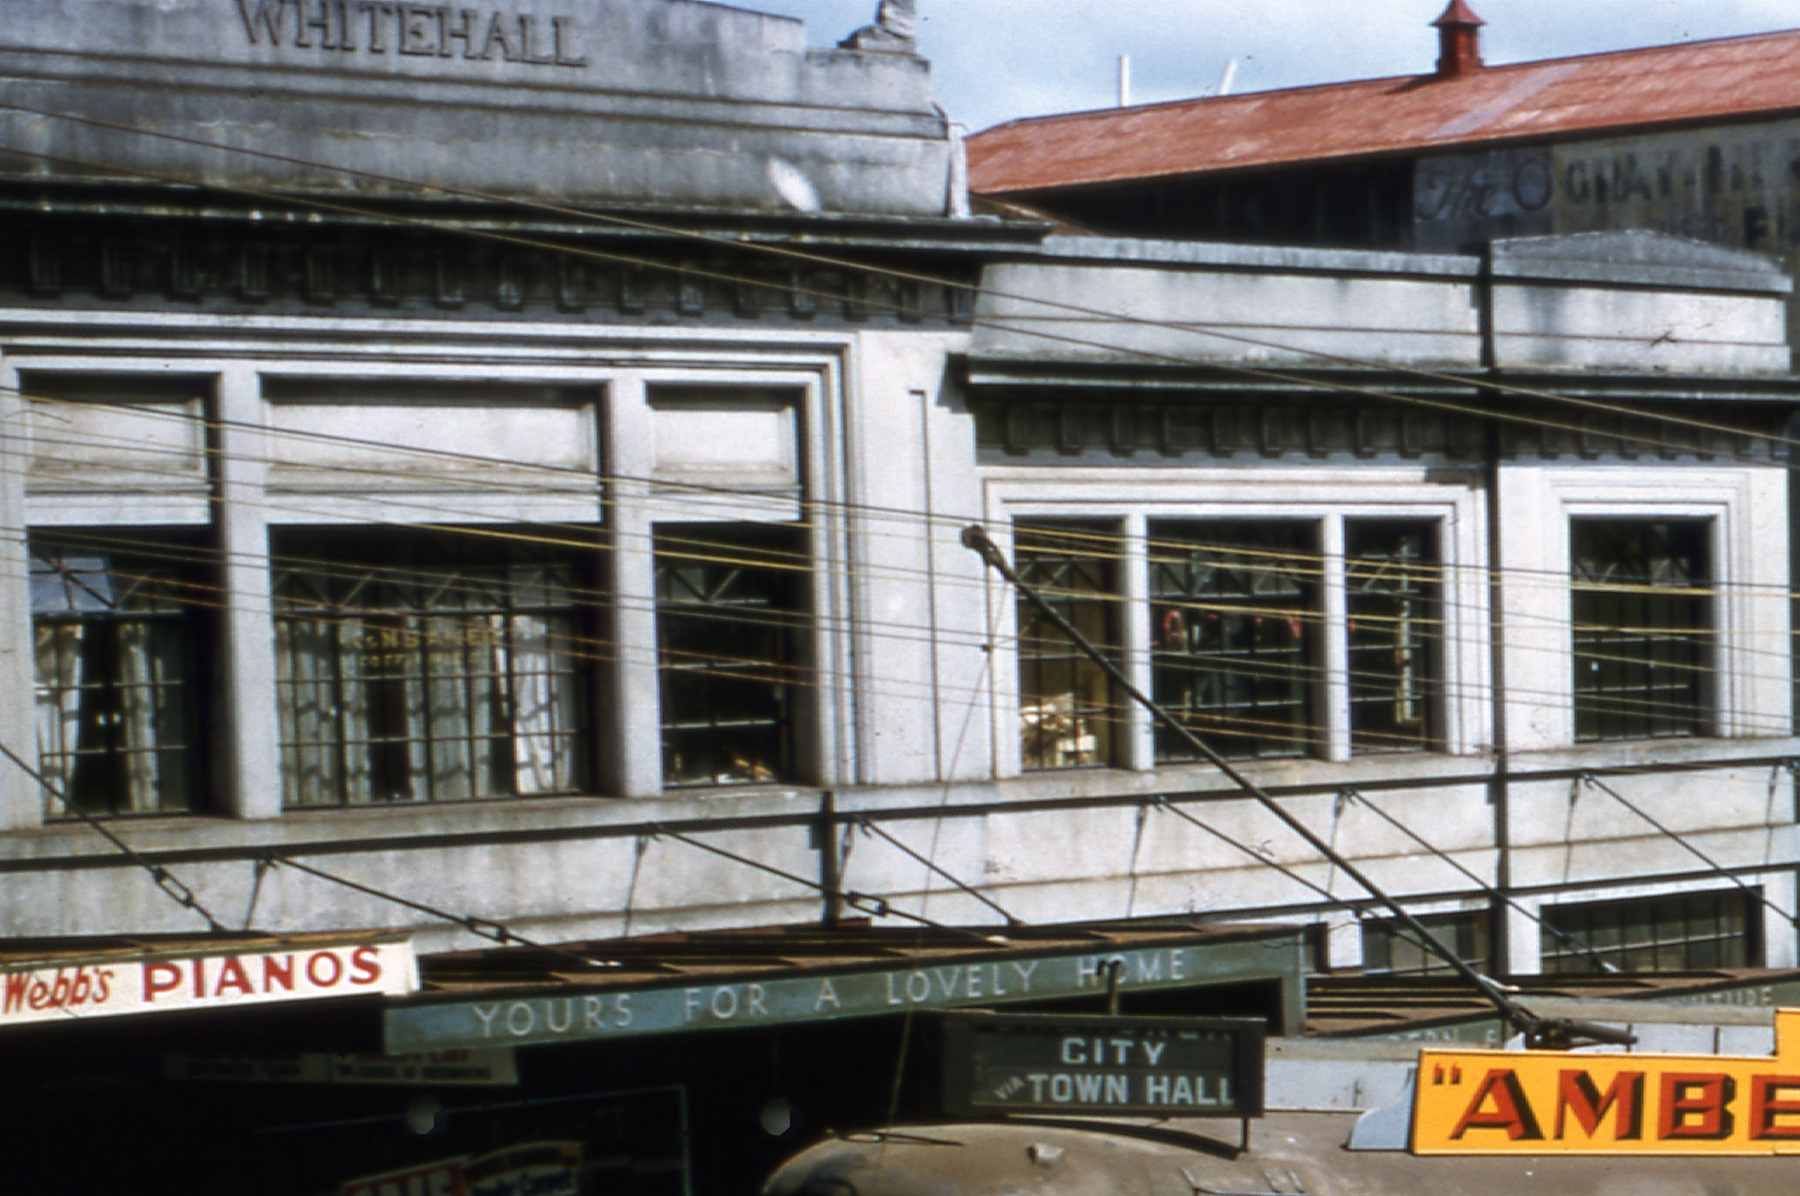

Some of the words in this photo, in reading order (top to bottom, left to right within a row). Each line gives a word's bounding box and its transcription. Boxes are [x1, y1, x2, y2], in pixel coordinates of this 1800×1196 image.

[235, 0, 590, 68] WHITEHALL
[1, 966, 115, 1014] Webb's
[140, 946, 382, 1002] PIANOS
[472, 991, 633, 1038] YOURS
[684, 981, 769, 1021] FOR
[813, 978, 842, 1009] A
[887, 963, 1035, 1005] LOVELY
[1075, 947, 1187, 987] HOME
[1060, 1036, 1167, 1067] CITY
[1027, 1073, 1130, 1105] TOWN
[1145, 1074, 1236, 1107] HALL
